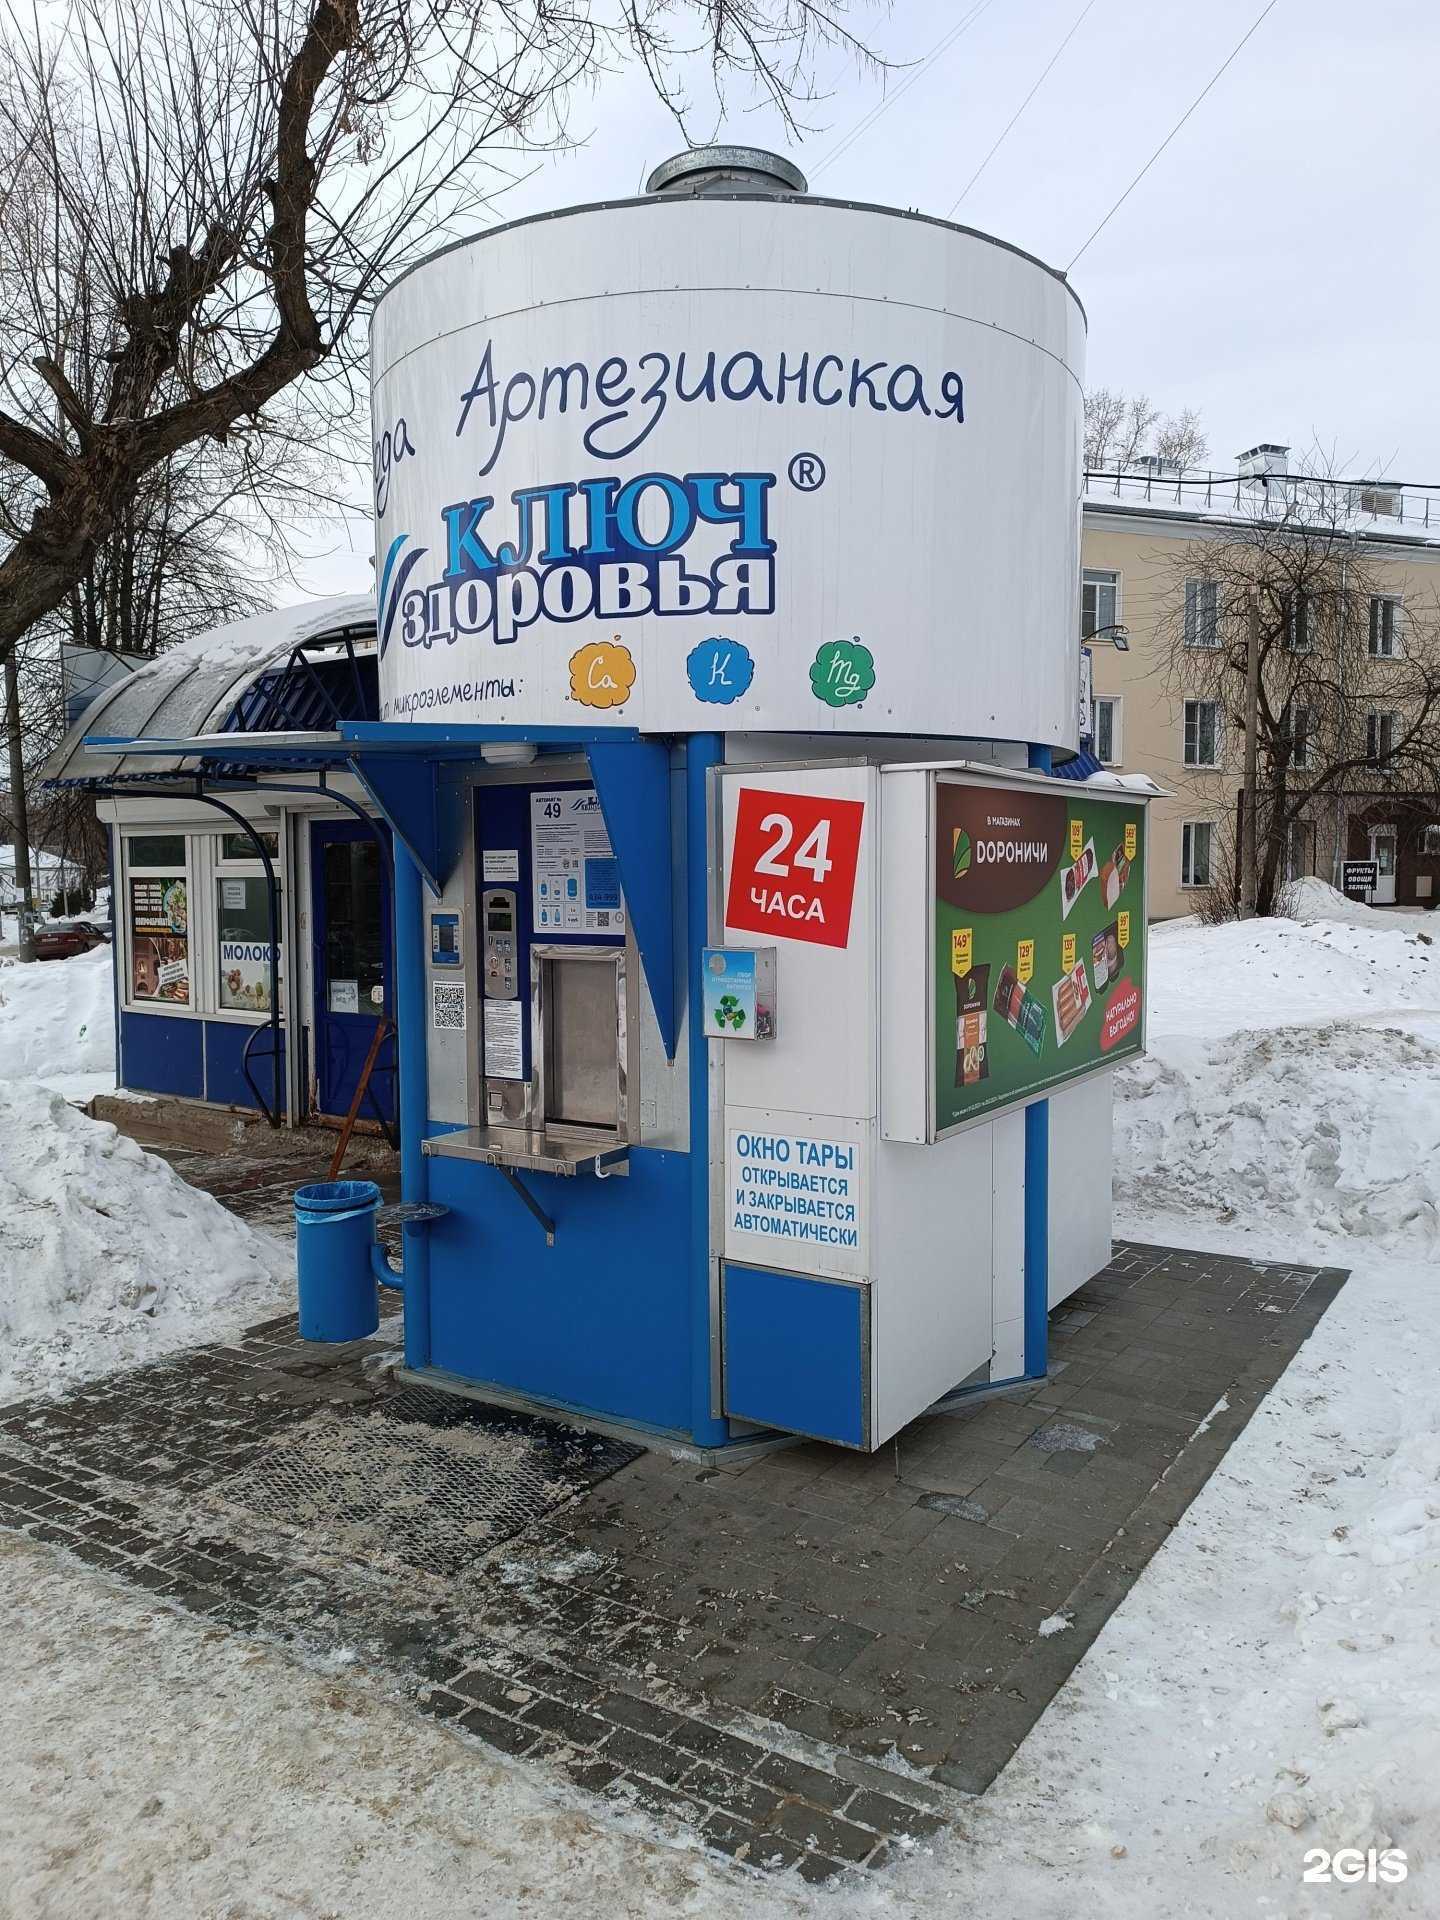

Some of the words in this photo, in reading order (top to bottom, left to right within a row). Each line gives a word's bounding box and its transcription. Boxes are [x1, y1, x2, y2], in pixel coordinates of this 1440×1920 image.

[456, 339, 965, 477] Артезианская
[393, 678, 523, 722] микроэлементы:
[543, 803, 561, 818] 49
[992, 816, 1021, 827] МАГАЗИНАХ
[753, 813, 833, 883] 24
[750, 887, 825, 923] ЧАСА
[954, 934, 967, 949] 149
[1020, 944, 1030, 959] 129
[736, 1134, 790, 1162] ОКНО
[795, 1141, 853, 1170] ТАРЫ
[742, 1166, 848, 1196] ОТКРЫВАЕТСЯ
[736, 1188, 745, 1205] И
[748, 1190, 855, 1221] ЗАКРЫВАЕТСЯ
[734, 1212, 857, 1246] АВТОМАТИЧЕСКИ
